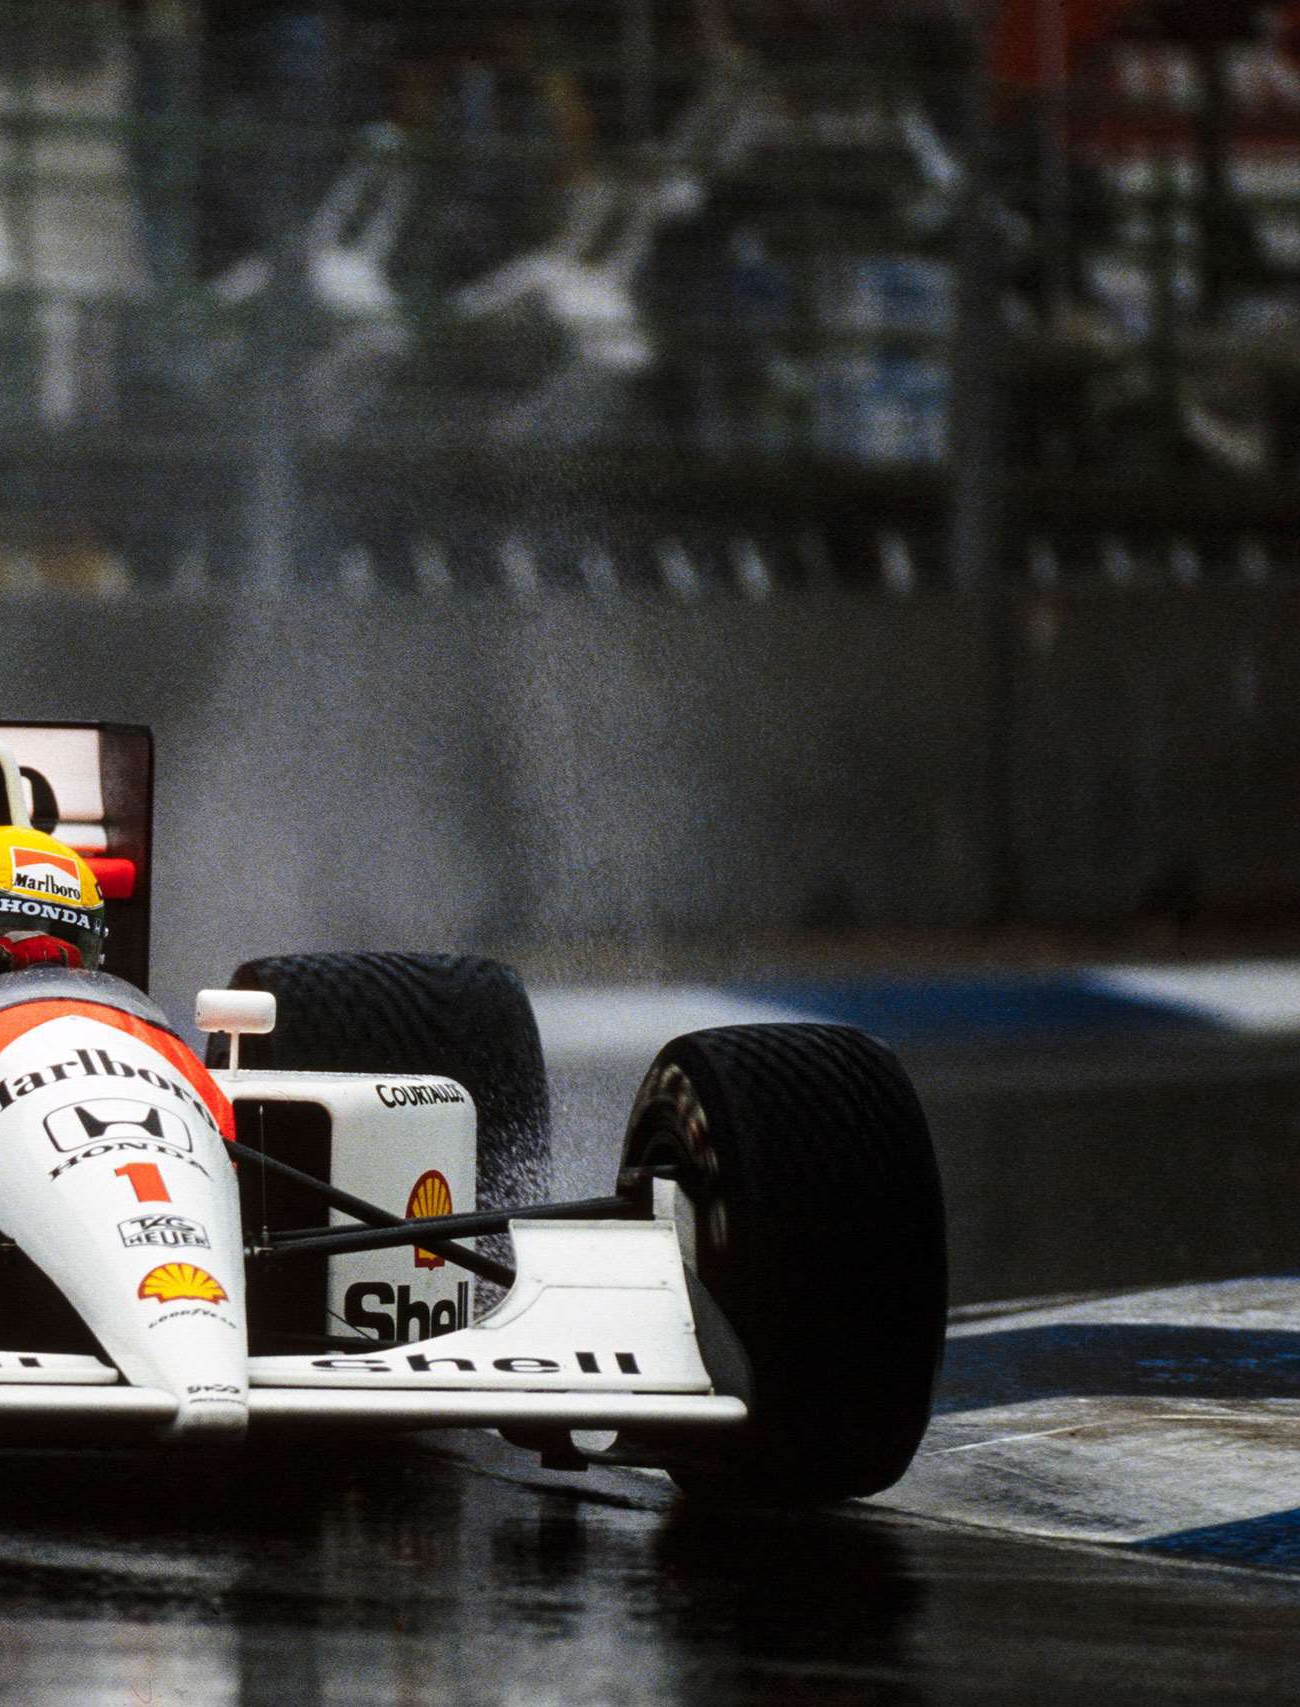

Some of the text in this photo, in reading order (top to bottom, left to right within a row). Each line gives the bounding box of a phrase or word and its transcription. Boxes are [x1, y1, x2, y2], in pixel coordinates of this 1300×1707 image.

[12, 873, 81, 900] Marlboro
[0, 898, 90, 929] HONDA
[48, 1142, 213, 1182] HONDA
[114, 1162, 172, 1203] 1
[129, 1230, 208, 1246] HEUER
[344, 1281, 469, 1343] Shell
[311, 1351, 642, 1375] Shell
